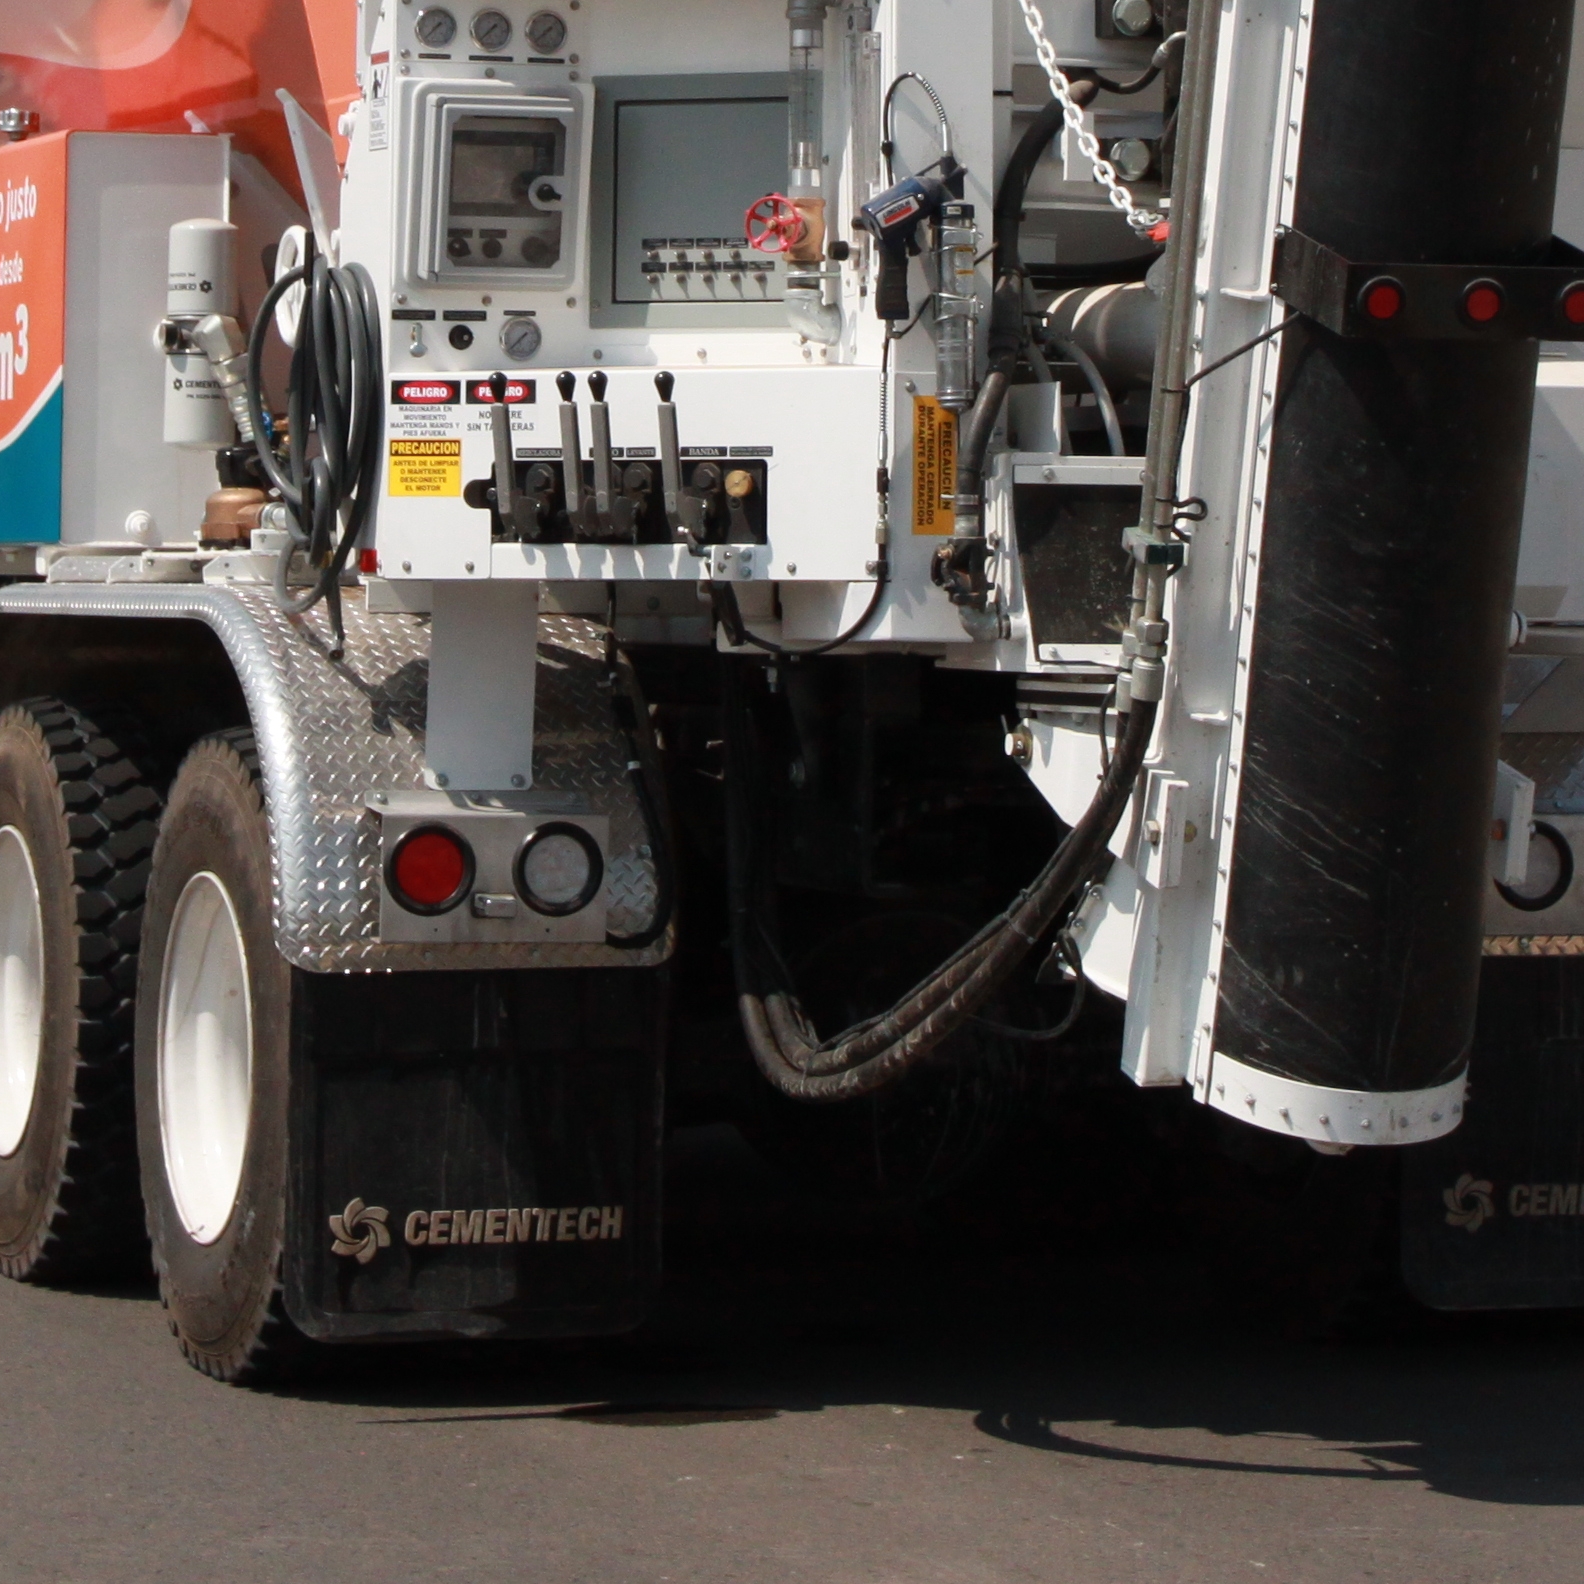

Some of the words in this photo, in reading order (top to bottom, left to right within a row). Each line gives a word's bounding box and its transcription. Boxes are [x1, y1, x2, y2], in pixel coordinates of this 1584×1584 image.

[4, 175, 38, 233] justo
[403, 386, 448, 398] PELIGRO
[391, 441, 459, 455] PRECAUCION
[466, 422, 482, 432] SIN
[917, 405, 926, 457] DURANTE
[926, 406, 935, 469] MANTENGA
[688, 448, 720, 456] BANDA
[917, 462, 926, 526] OPERACION
[926, 472, 935, 525] CERRADO
[403, 1205, 624, 1246] CEMENTECH
